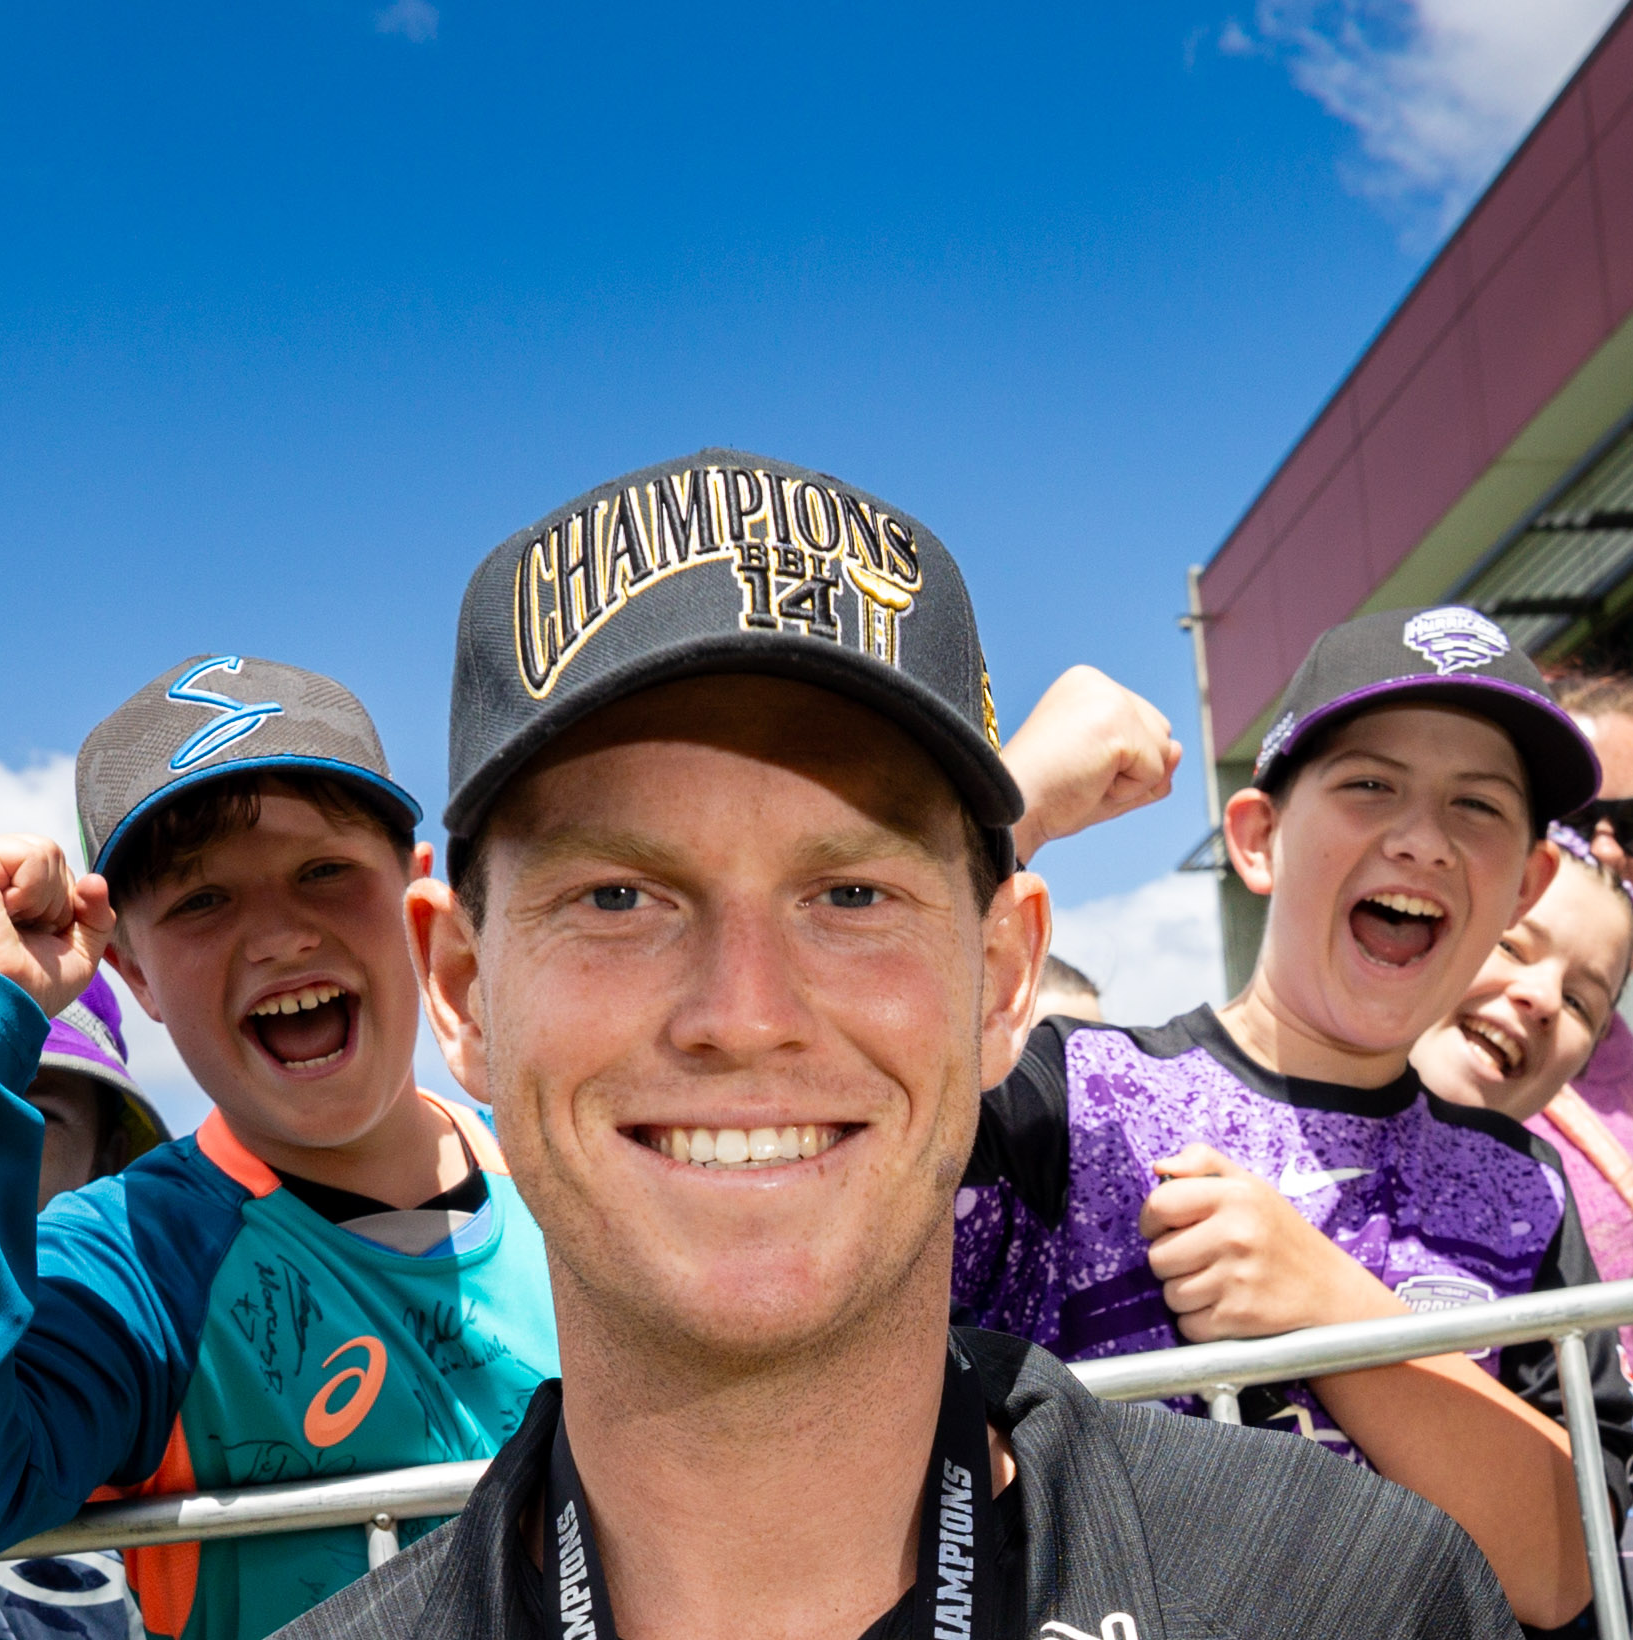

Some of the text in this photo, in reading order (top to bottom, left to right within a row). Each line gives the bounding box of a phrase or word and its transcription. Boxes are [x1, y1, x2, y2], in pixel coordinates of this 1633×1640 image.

[516, 466, 923, 699] CHAMPIONS
[735, 540, 840, 582] BBL
[740, 567, 842, 641] 14
